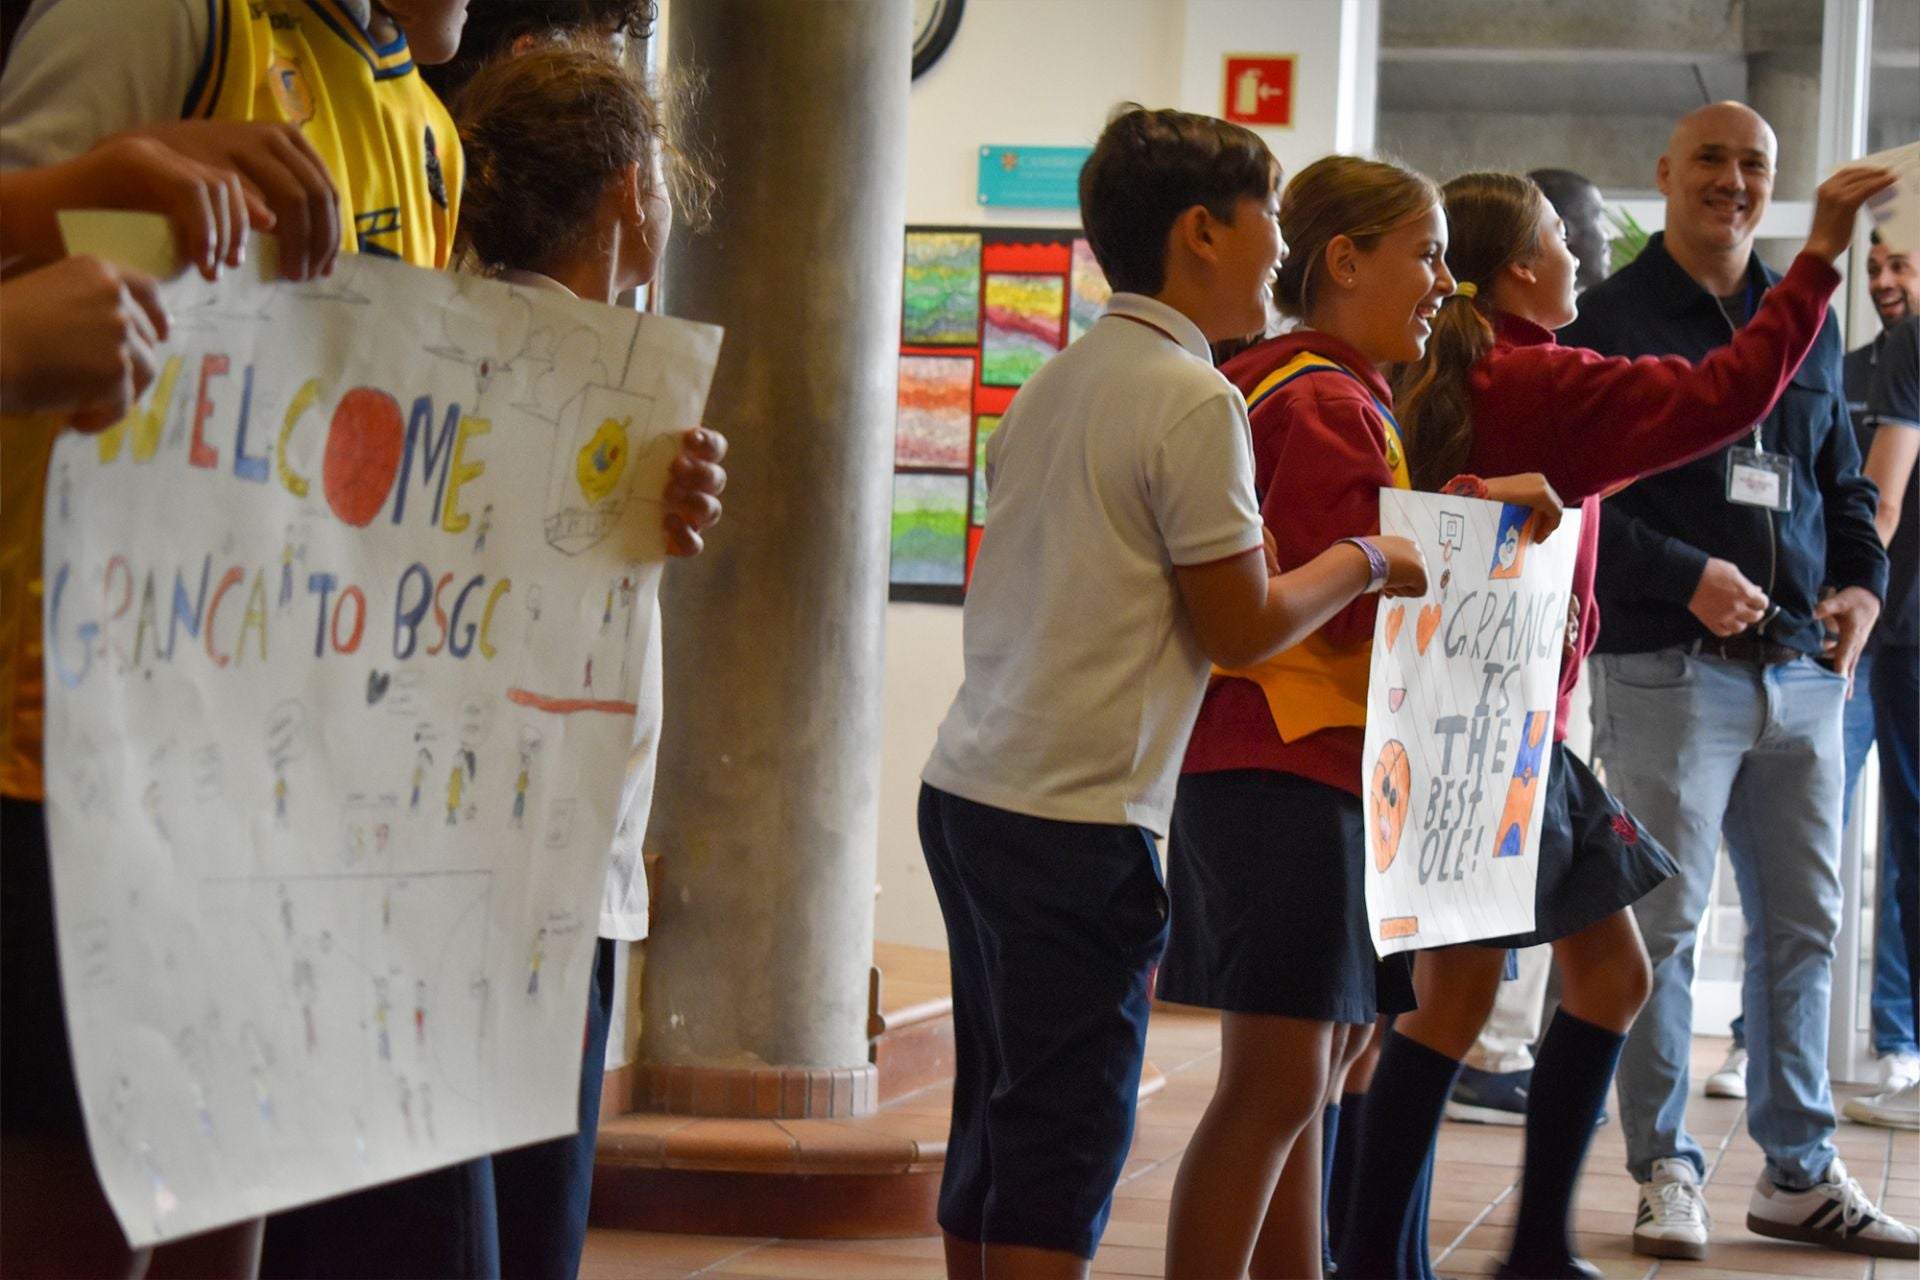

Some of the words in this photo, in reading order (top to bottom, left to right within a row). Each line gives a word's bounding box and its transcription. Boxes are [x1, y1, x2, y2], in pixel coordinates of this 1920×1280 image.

[97, 353, 493, 534] WELCOME
[50, 554, 269, 689] GRANCA
[307, 571, 368, 658] TO
[392, 561, 511, 660] BSGC
[1473, 662, 1521, 717] IS
[1434, 715, 1512, 776] THE
[1418, 825, 1485, 885] OLE!
